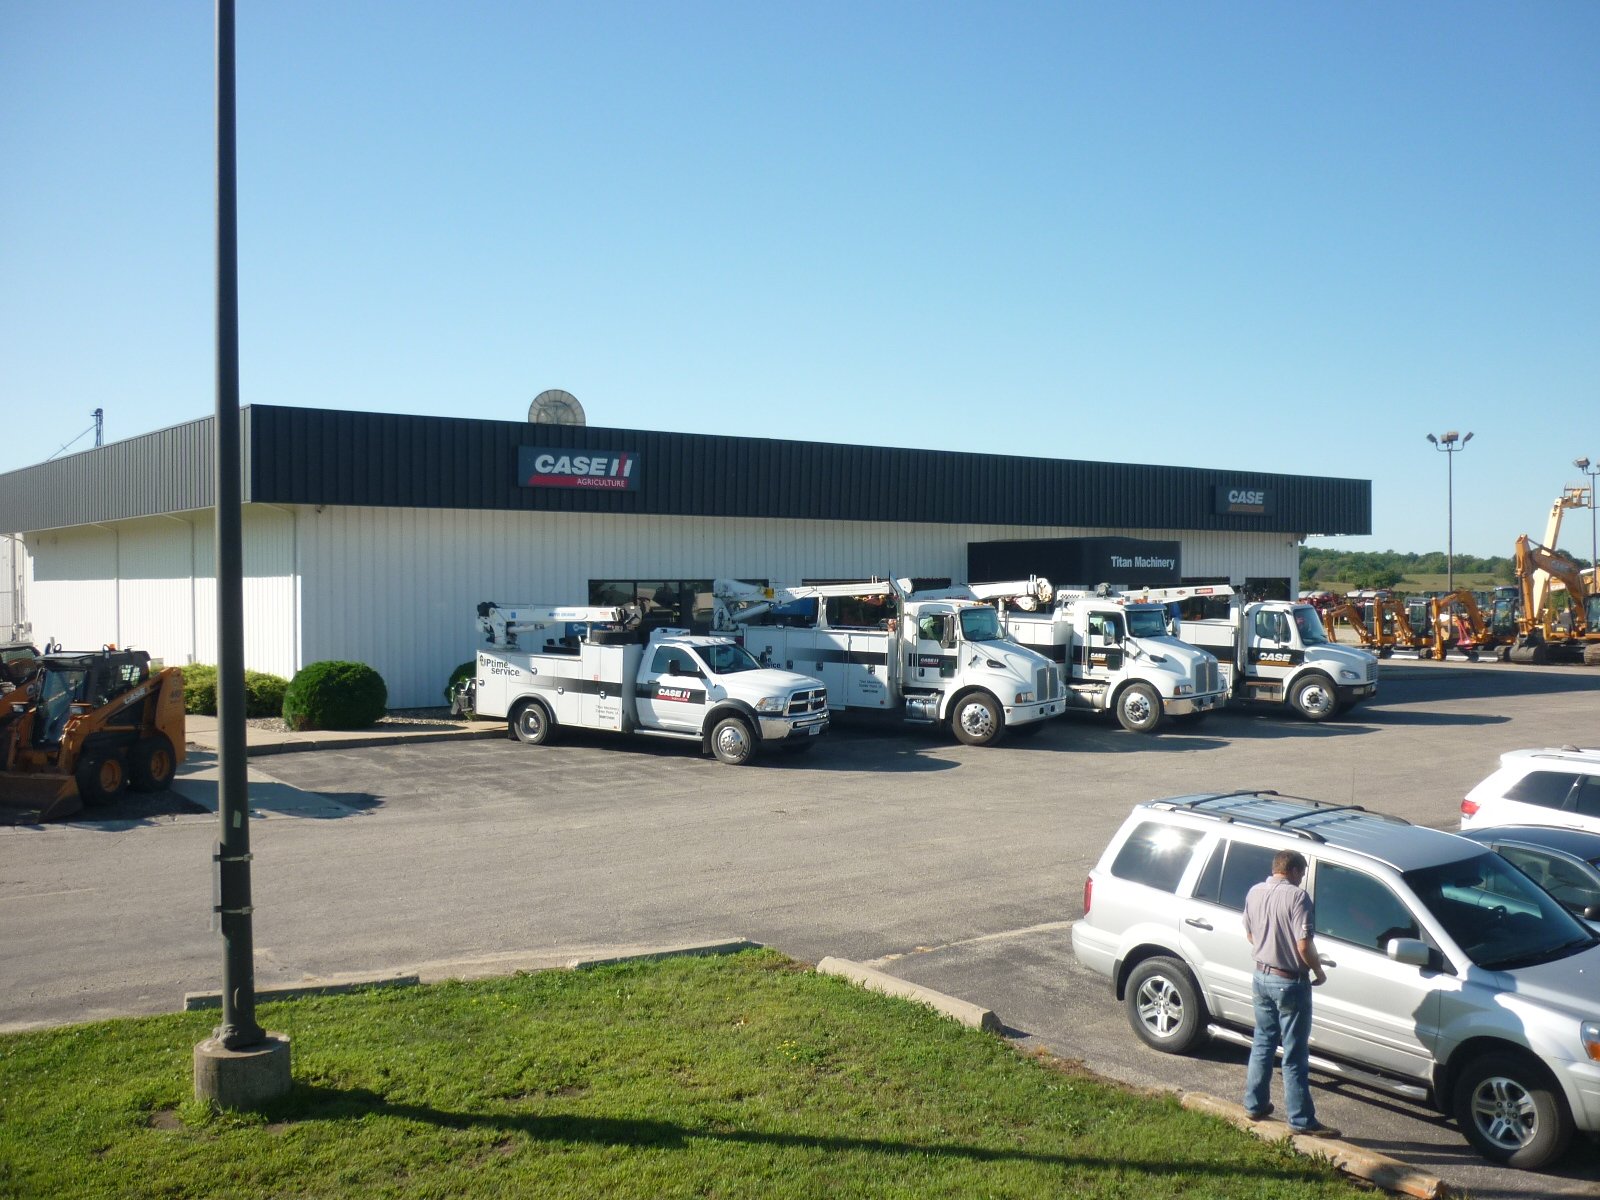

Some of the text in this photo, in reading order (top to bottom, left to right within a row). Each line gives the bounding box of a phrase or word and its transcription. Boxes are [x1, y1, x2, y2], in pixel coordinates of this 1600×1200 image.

[535, 454, 608, 476] CASE
[577, 479, 625, 488] AGRICULTURE
[1228, 490, 1265, 505] CASE
[1110, 555, 1175, 571] Titan Machinery
[1259, 652, 1292, 662] CASE
[491, 667, 521, 676] service
[658, 688, 682, 698] CASE
